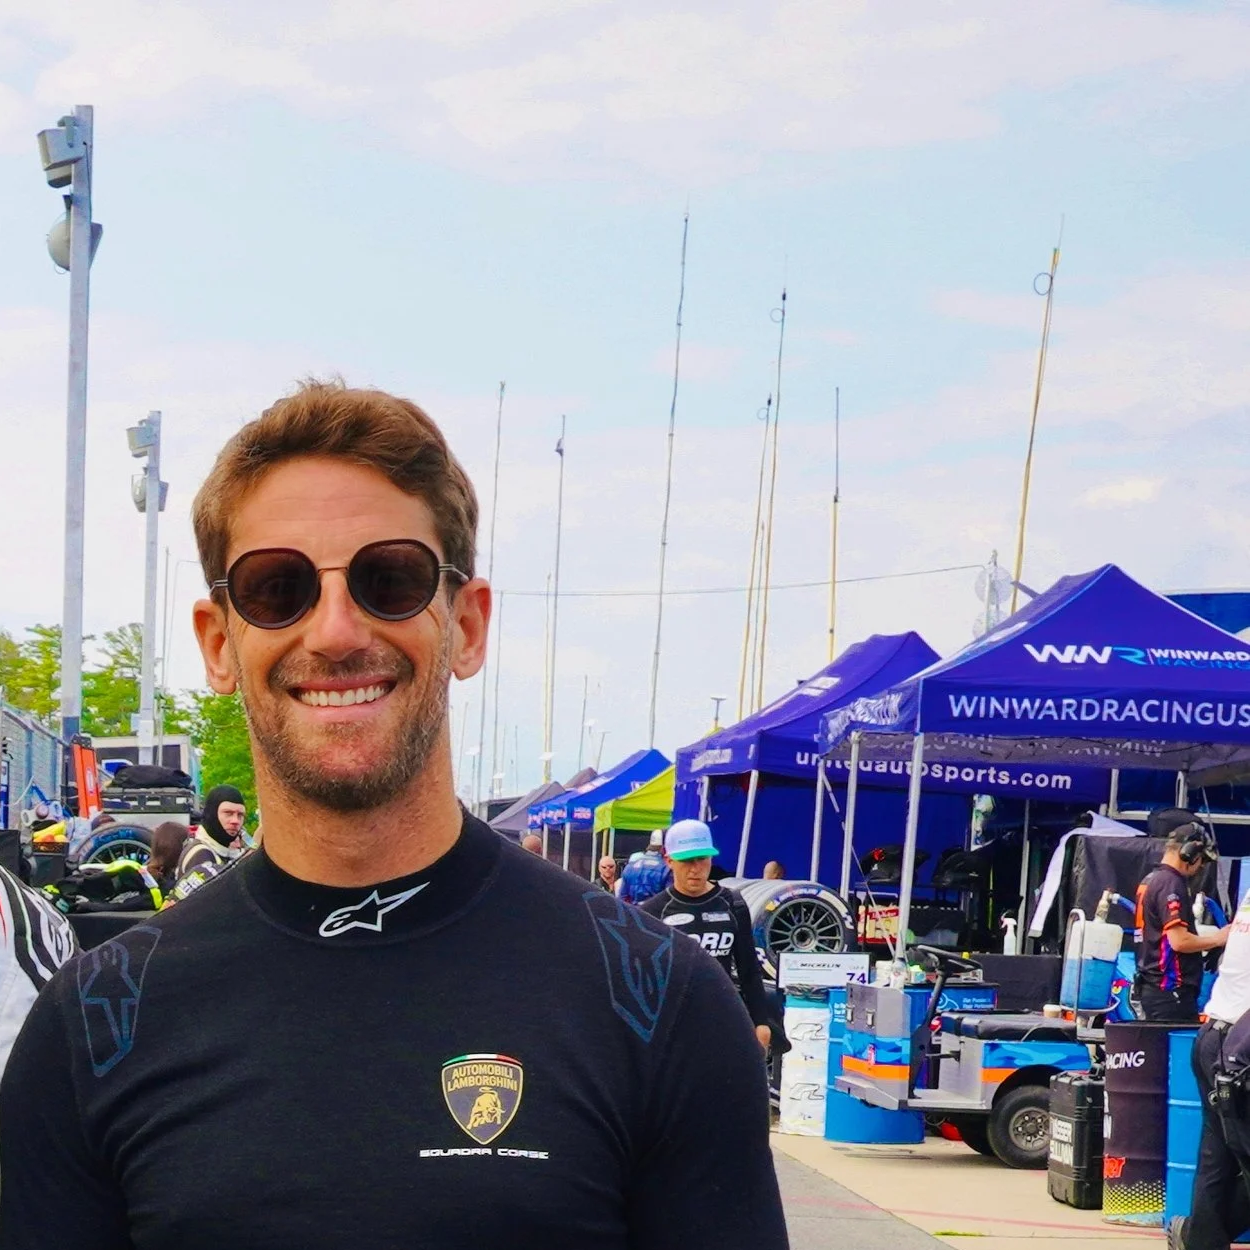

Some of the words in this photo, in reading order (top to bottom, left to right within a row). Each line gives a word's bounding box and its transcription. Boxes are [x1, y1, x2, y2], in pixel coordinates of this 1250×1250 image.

[1150, 648, 1250, 661] WINWARD
[846, 972, 867, 985] 74
[451, 1064, 514, 1080] AUTOMOBILI
[447, 1075, 519, 1093] LAMBORGHINI
[419, 1148, 492, 1158] SQUADRA
[497, 1149, 549, 1160] CORSE
